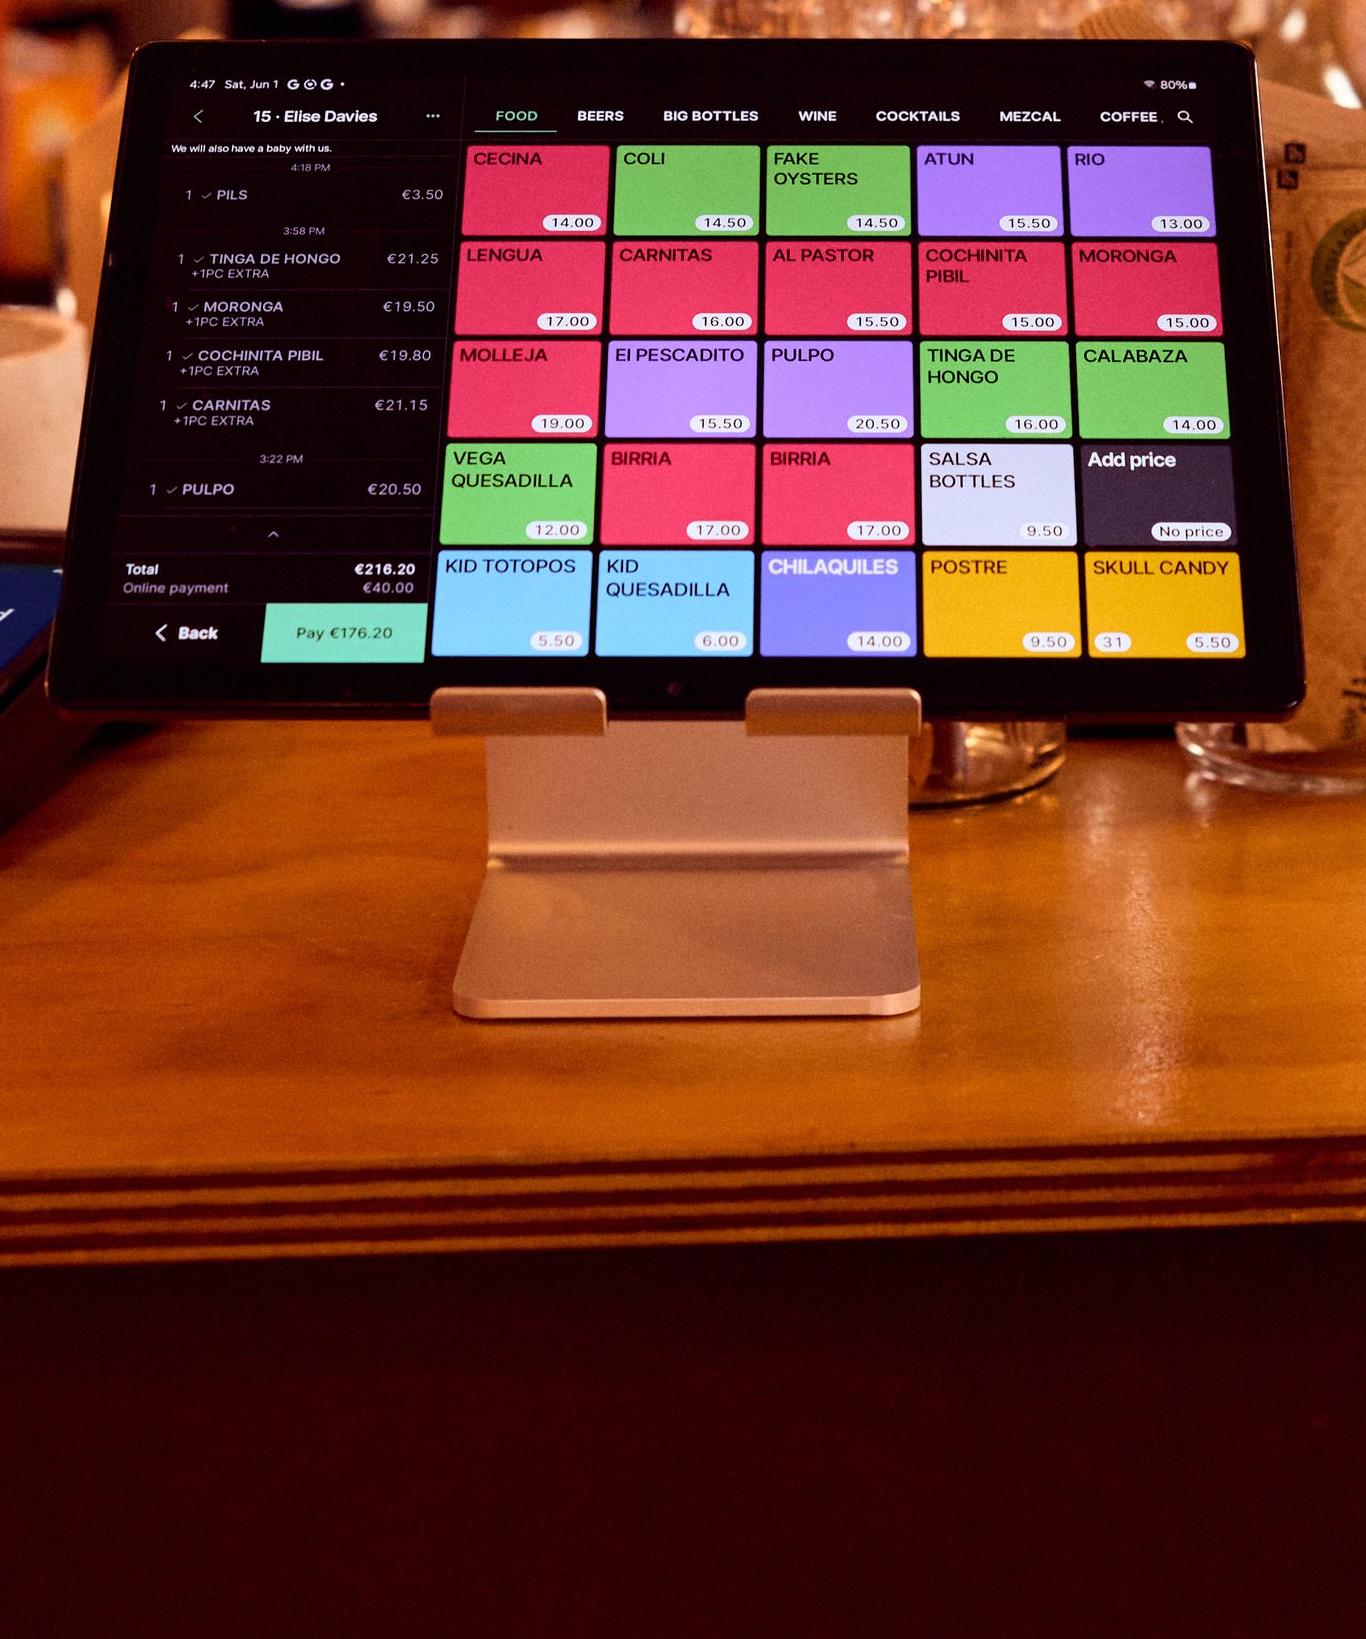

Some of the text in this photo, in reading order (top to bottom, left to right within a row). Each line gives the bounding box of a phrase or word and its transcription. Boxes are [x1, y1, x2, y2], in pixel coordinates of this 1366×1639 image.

[190, 80, 278, 89] 4:47 Sat, Jun 1
[1161, 80, 1190, 89] 80%
[254, 111, 271, 122] 15
[284, 110, 320, 122] Elise
[325, 110, 377, 122] Davies
[496, 111, 537, 121] FOOD
[578, 111, 624, 121] BEERS
[664, 111, 758, 121] BIG BOTTLES
[799, 111, 836, 121] WINE
[876, 111, 960, 121] COCKTAILS
[1000, 111, 1061, 122] MEZCAL
[1100, 112, 1157, 122] COFFEE
[267, 145, 291, 154] baby
[295, 144, 315, 152] with
[474, 152, 542, 165] CECINA
[624, 153, 664, 164] COLI
[775, 153, 819, 165] FAKE
[924, 153, 973, 165] ATUN
[1075, 153, 1105, 165] RIO
[774, 173, 858, 185] OYSTERS
[187, 189, 443, 200] 1 PILS €3.50
[551, 217, 595, 229] 14.00
[703, 217, 747, 229] 14.50
[855, 218, 898, 229] 14.50
[1007, 218, 1051, 229] 15.50
[1159, 218, 1203, 230] 13.00
[284, 227, 325, 235] 3:58 PM
[179, 253, 438, 264] 1 TINGA DE HONGO €21.25
[467, 249, 543, 261] LENGUA
[620, 248, 712, 262] CARNITAS
[773, 249, 874, 262] AL PASTOR
[926, 249, 1027, 262] COCHINITA
[1080, 249, 1177, 263] MORONGA
[192, 269, 269, 278] +1PC EXTRA
[926, 270, 969, 283] PIBIL
[173, 301, 434, 312] 1 MORONGA €19.50
[186, 317, 264, 326] +1PC EXTRA
[546, 316, 590, 328] 17.00
[701, 316, 745, 328] 16.00
[855, 316, 899, 328] 15.50
[1011, 317, 1055, 328] 15.00
[1165, 317, 1210, 329] 15.00
[167, 350, 431, 361] 1 COCHINITA PIBIL €19.80
[460, 348, 547, 362] MOLLEJA
[636, 348, 744, 361] PESCADITO
[772, 349, 834, 361] PULPO
[927, 349, 1015, 362] TINGA DE
[1084, 349, 1188, 362] CALABAZA
[180, 366, 259, 376] +1PC EXTRA
[928, 370, 998, 383] HONGO
[161, 400, 427, 410] 1 CARNITAS €21.15
[174, 416, 253, 426] +1PC EXTRA
[540, 418, 585, 430] 19.00
[699, 418, 743, 430] 15.50
[855, 418, 900, 430] 20.50
[1014, 419, 1059, 430] 16.00
[1172, 419, 1217, 431] 14.00
[260, 455, 303, 463] 3:22 PM
[454, 452, 506, 465] VEGA
[612, 451, 671, 465] BIRRIA
[771, 452, 831, 465] BIRRIA
[930, 452, 991, 465] SALSA
[1088, 452, 1176, 470] Add price
[452, 474, 572, 488] QUESADILLA
[930, 475, 1015, 488] BOTTLES
[150, 484, 421, 495] 1 PULPO €20.50
[534, 524, 580, 536] 12.00
[696, 524, 741, 536] 17.00
[856, 525, 902, 537] 17.00
[1026, 525, 1063, 537] 9.50
[1159, 525, 1224, 540] No price
[126, 563, 415, 575] Total €216.20
[446, 559, 575, 573] KID TOTOPOS
[608, 559, 638, 573] KID
[769, 559, 898, 575] CHILAQUILES
[931, 560, 1007, 574] POSTRE
[1094, 561, 1228, 575] SKULL CANDY
[123, 582, 413, 595] Online payment €40.00
[607, 583, 729, 597] QUESADILLA
[179, 626, 218, 640] Back
[297, 627, 392, 641] Pay €176.20
[538, 635, 575, 647] 5.50
[702, 635, 739, 647] 6.00
[857, 636, 903, 648] 14.00
[1030, 636, 1067, 648] 9.50
[1102, 636, 1123, 648] 31
[1194, 636, 1231, 649] 5.50
